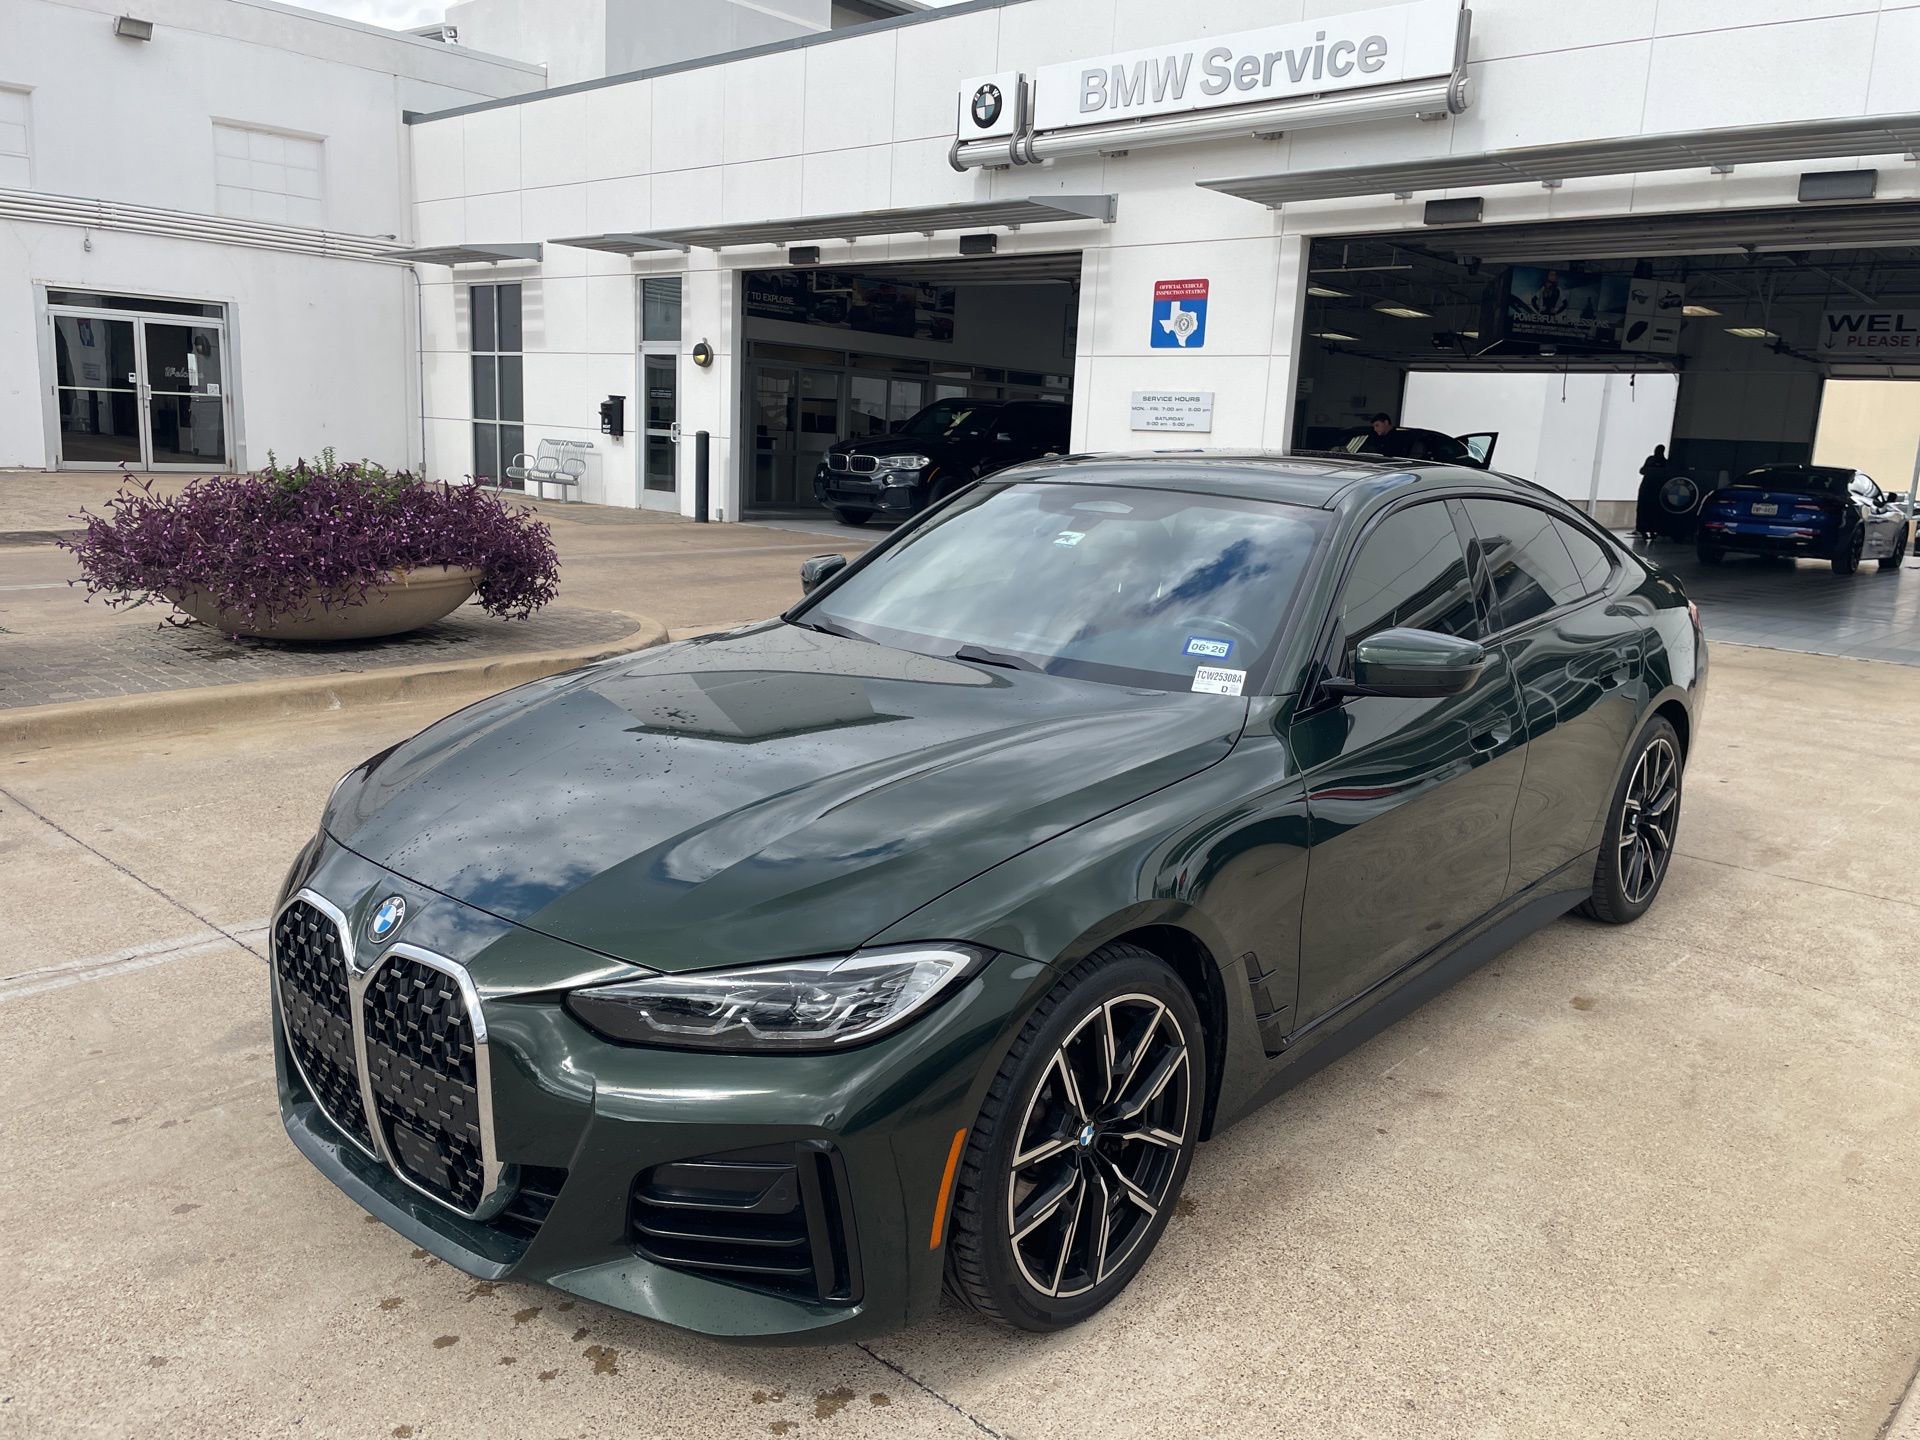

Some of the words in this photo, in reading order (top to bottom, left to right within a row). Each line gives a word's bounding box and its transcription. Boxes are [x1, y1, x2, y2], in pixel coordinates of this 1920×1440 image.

[1079, 52, 1193, 114] BMW
[1199, 30, 1388, 96] Service
[1513, 312, 1556, 324] POWERFUL
[1827, 314, 1918, 332] WEL
[1847, 335, 1911, 347] PLEASE
[1191, 643, 1206, 652] 06
[1210, 645, 1226, 654] 26
[1197, 670, 1242, 684] TCW25308A
[1221, 685, 1229, 693] D
